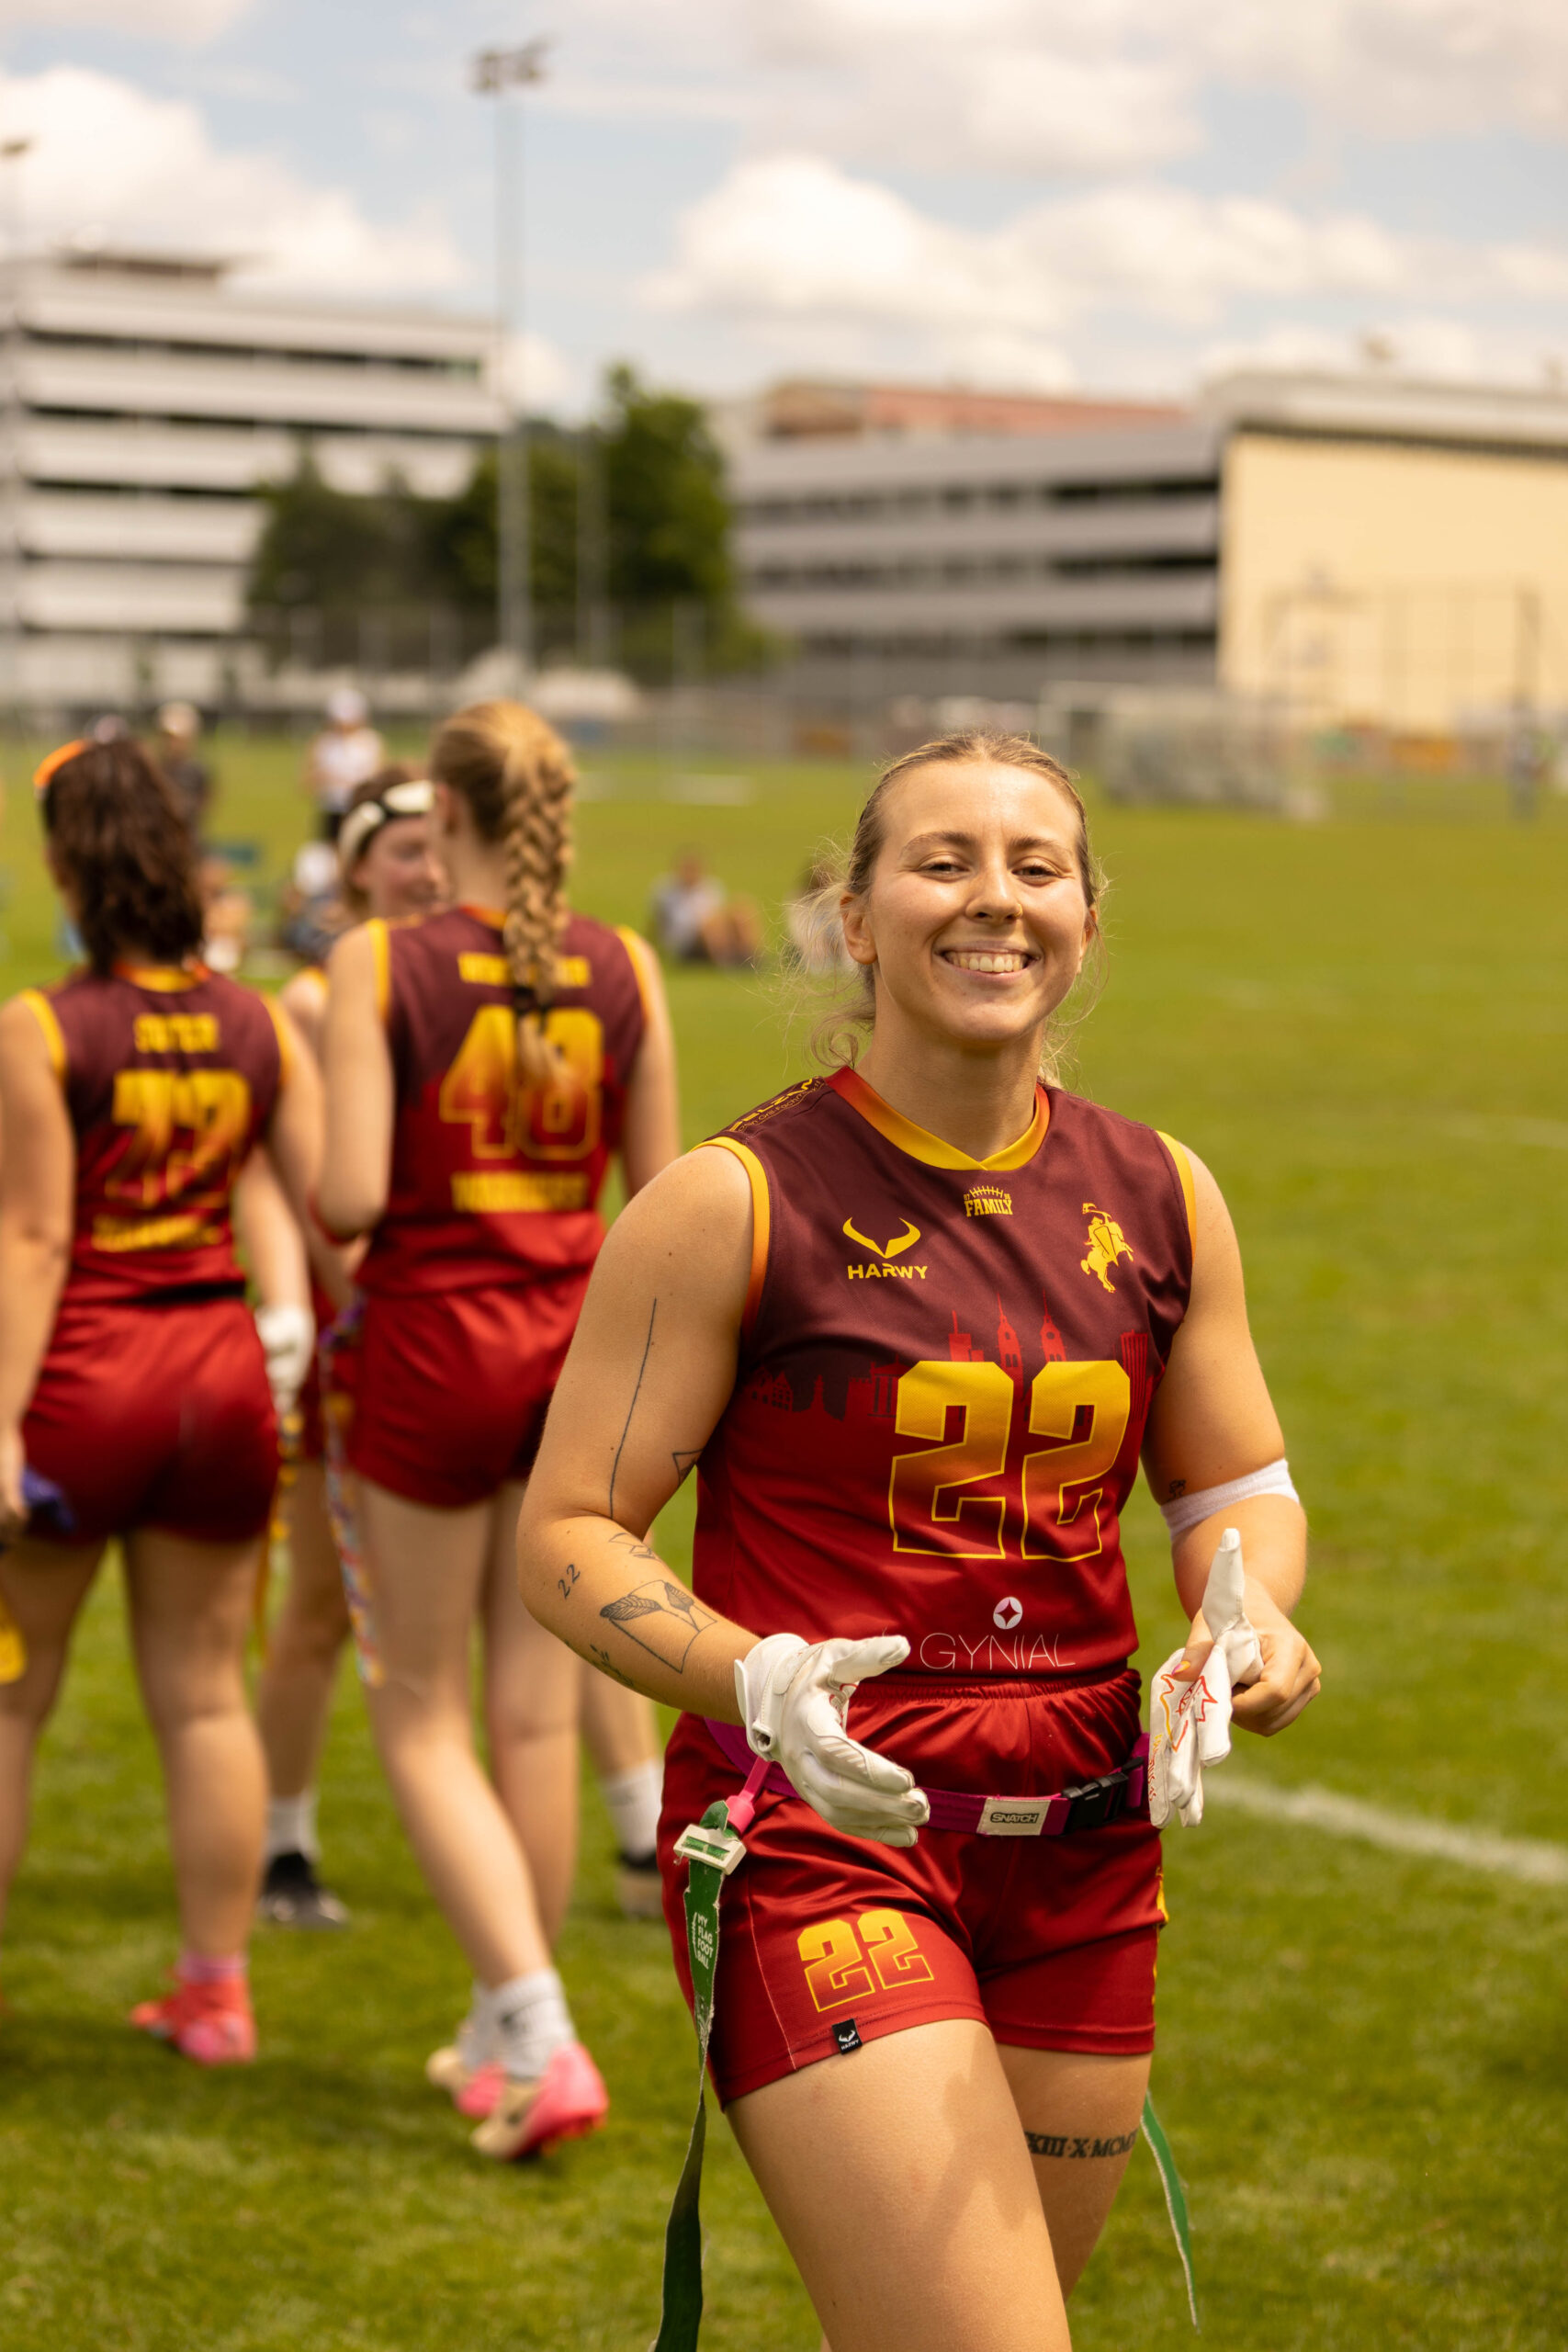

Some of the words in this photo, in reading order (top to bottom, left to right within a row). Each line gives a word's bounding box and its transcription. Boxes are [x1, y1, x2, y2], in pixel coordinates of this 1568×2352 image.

[964, 1198, 1013, 1217] FAMILY
[847, 1262, 928, 1280] HARWY
[888, 1360, 1131, 1562] 22
[558, 1564, 581, 1600] 22
[919, 1632, 1076, 1671] GYNIAL
[990, 1812, 1039, 1824] SNATCH
[697, 1913, 708, 1928] MY
[697, 1925, 713, 1945] FLAG
[697, 1938, 714, 1958] FOOT
[797, 1908, 934, 2013] 22
